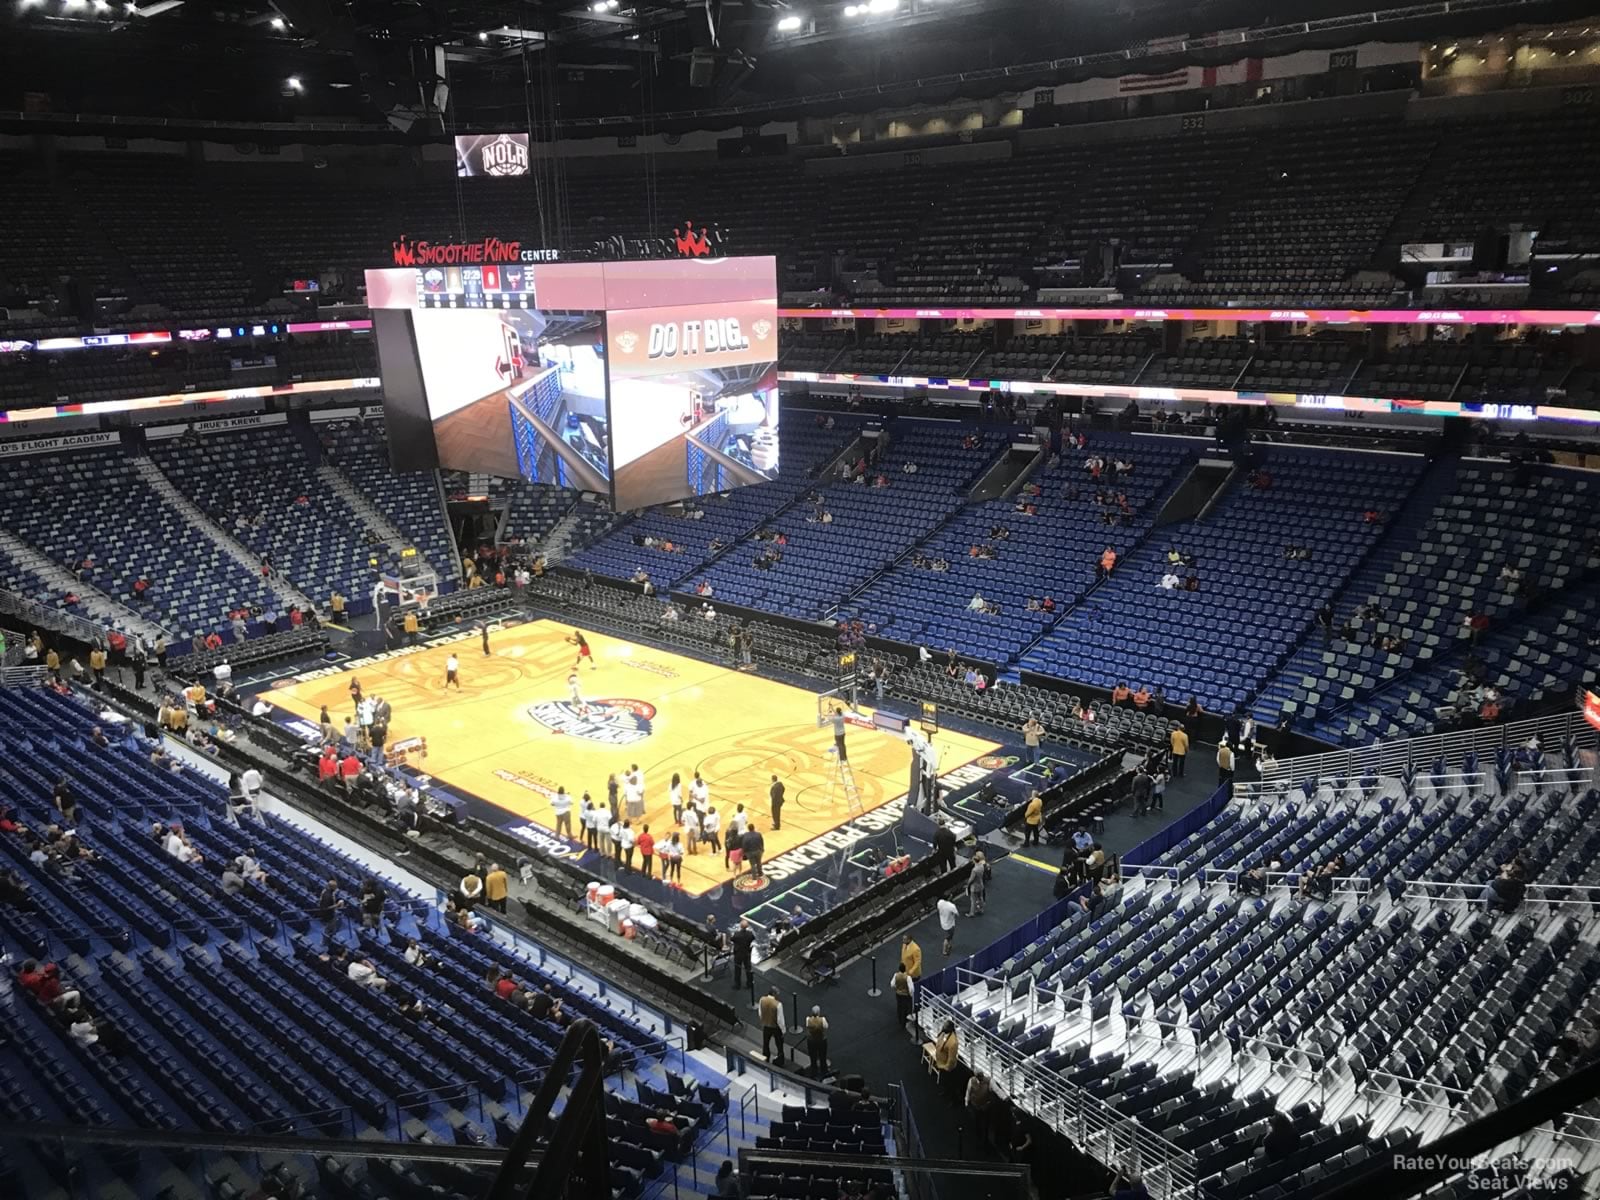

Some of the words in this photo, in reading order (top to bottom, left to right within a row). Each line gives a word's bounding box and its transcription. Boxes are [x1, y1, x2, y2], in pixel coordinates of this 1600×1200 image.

[1332, 54, 1354, 67] 301
[1182, 117, 1204, 129] 332
[485, 143, 526, 169] NOLA
[520, 249, 559, 262] CENTER
[648, 322, 680, 360] DO
[683, 319, 702, 356] IT
[703, 317, 749, 353] BIG.
[1482, 404, 1499, 417] DO
[199, 419, 228, 430] JRUE'S
[231, 416, 261, 426] KREWE
[21, 439, 59, 450] FLIGHT
[62, 433, 111, 445] ACADEMY
[936, 764, 994, 790] NEW
[762, 824, 869, 881] PELICANS
